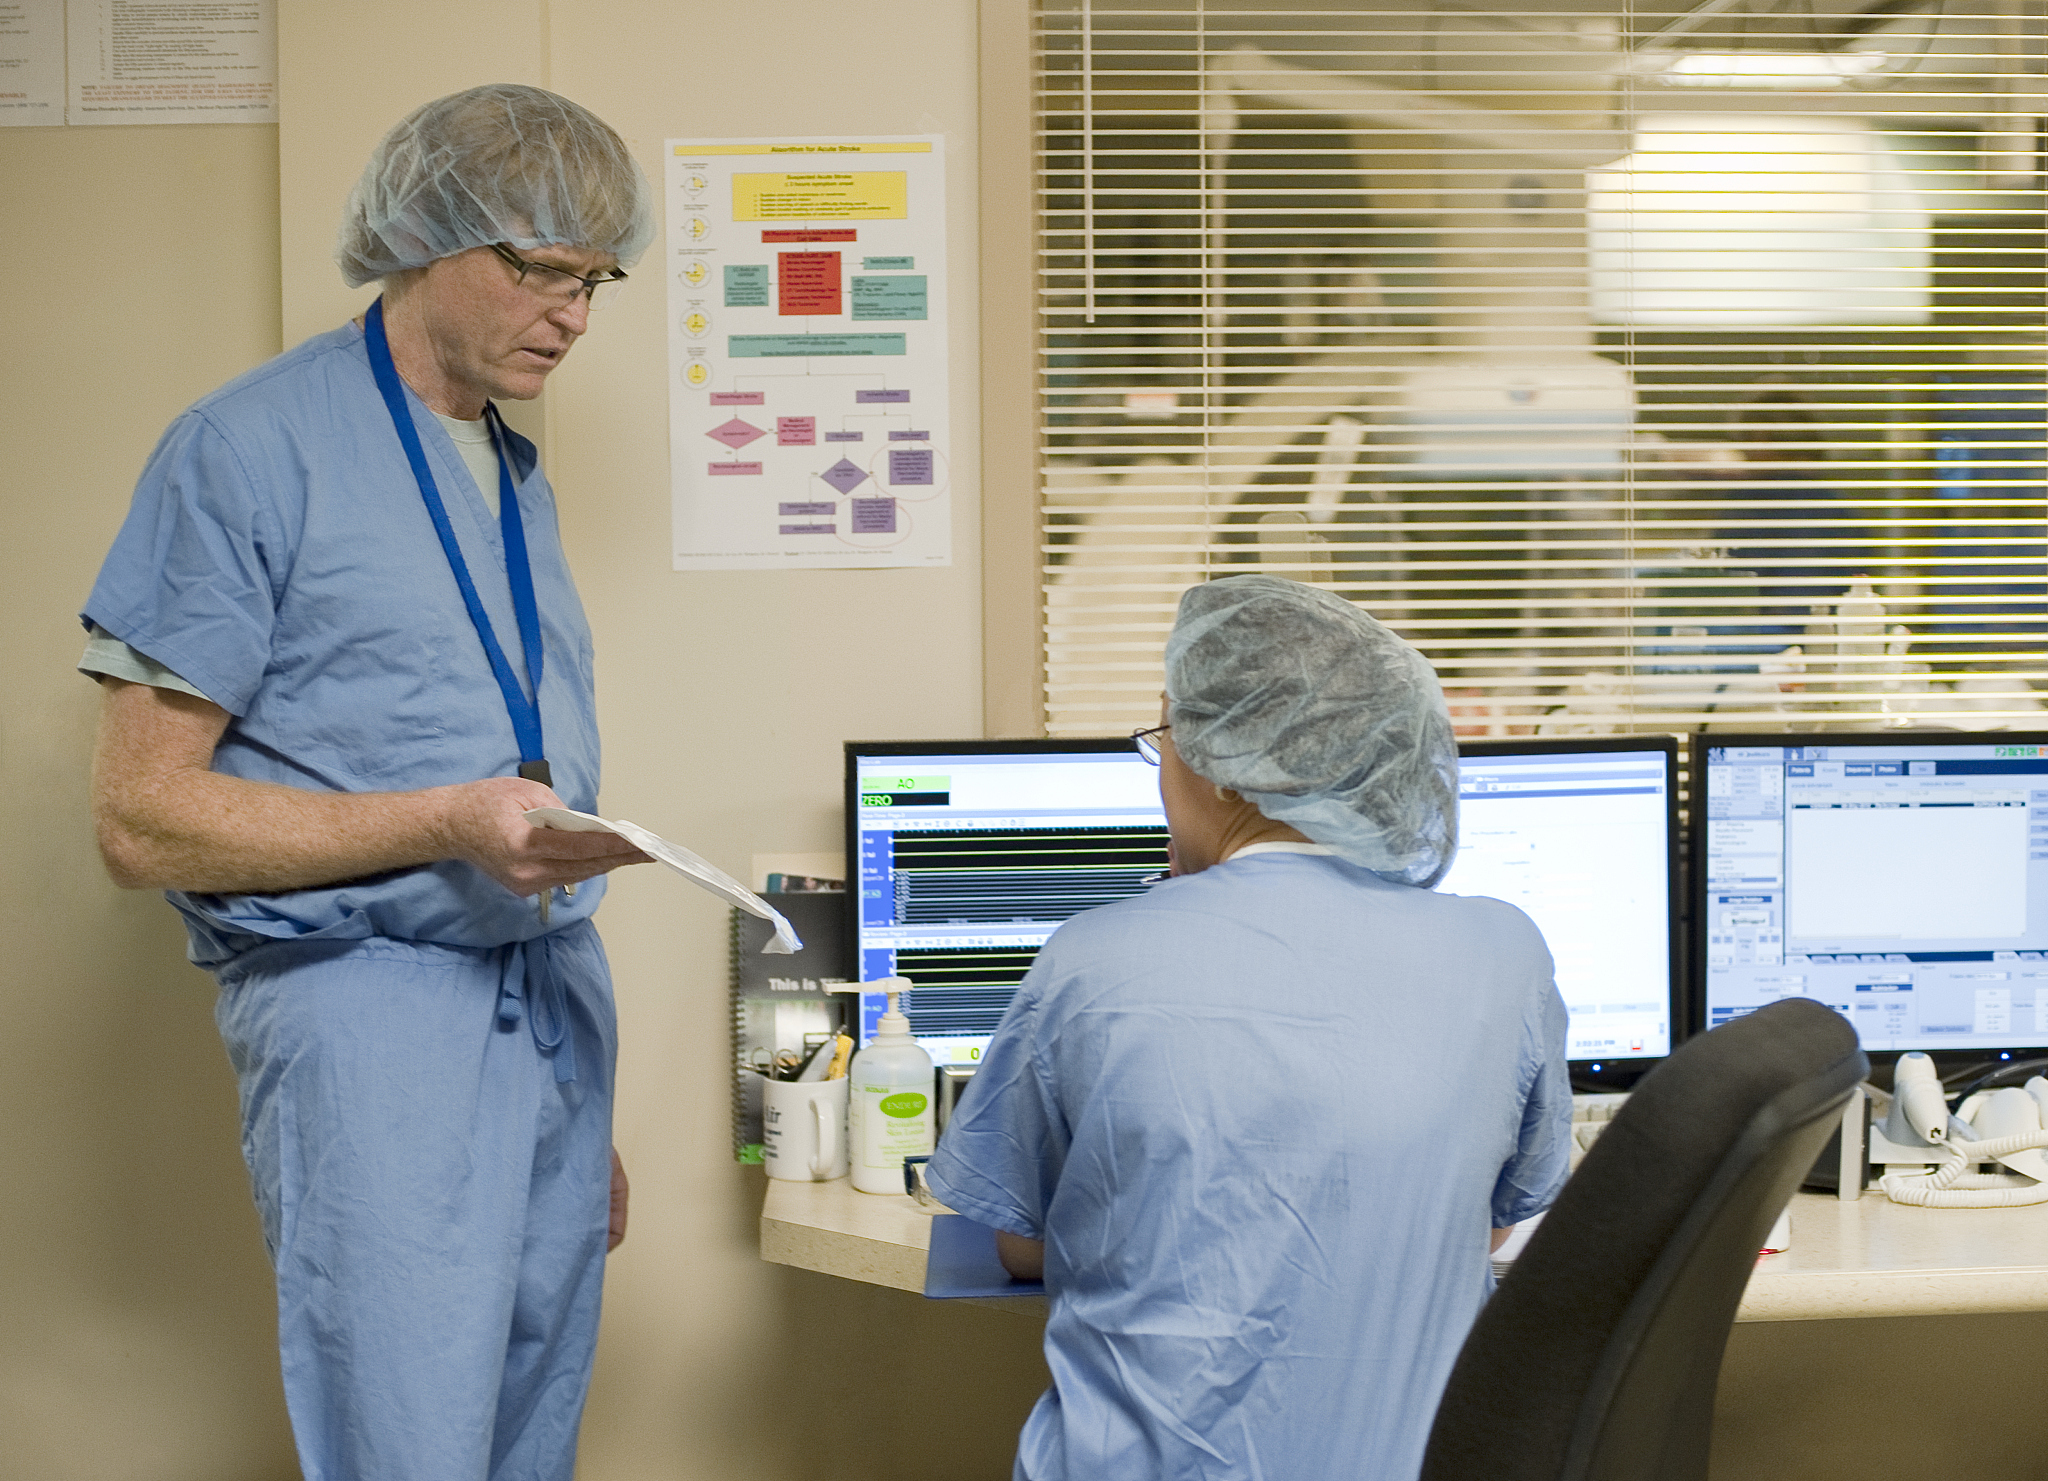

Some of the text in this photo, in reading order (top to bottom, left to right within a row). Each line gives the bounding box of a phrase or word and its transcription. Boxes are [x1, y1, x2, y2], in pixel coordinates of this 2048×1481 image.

[897, 778, 915, 789] AO
[862, 794, 893, 807] ZERO
[768, 977, 800, 991] This
[802, 977, 817, 991] is
[970, 1047, 980, 1060] 0
